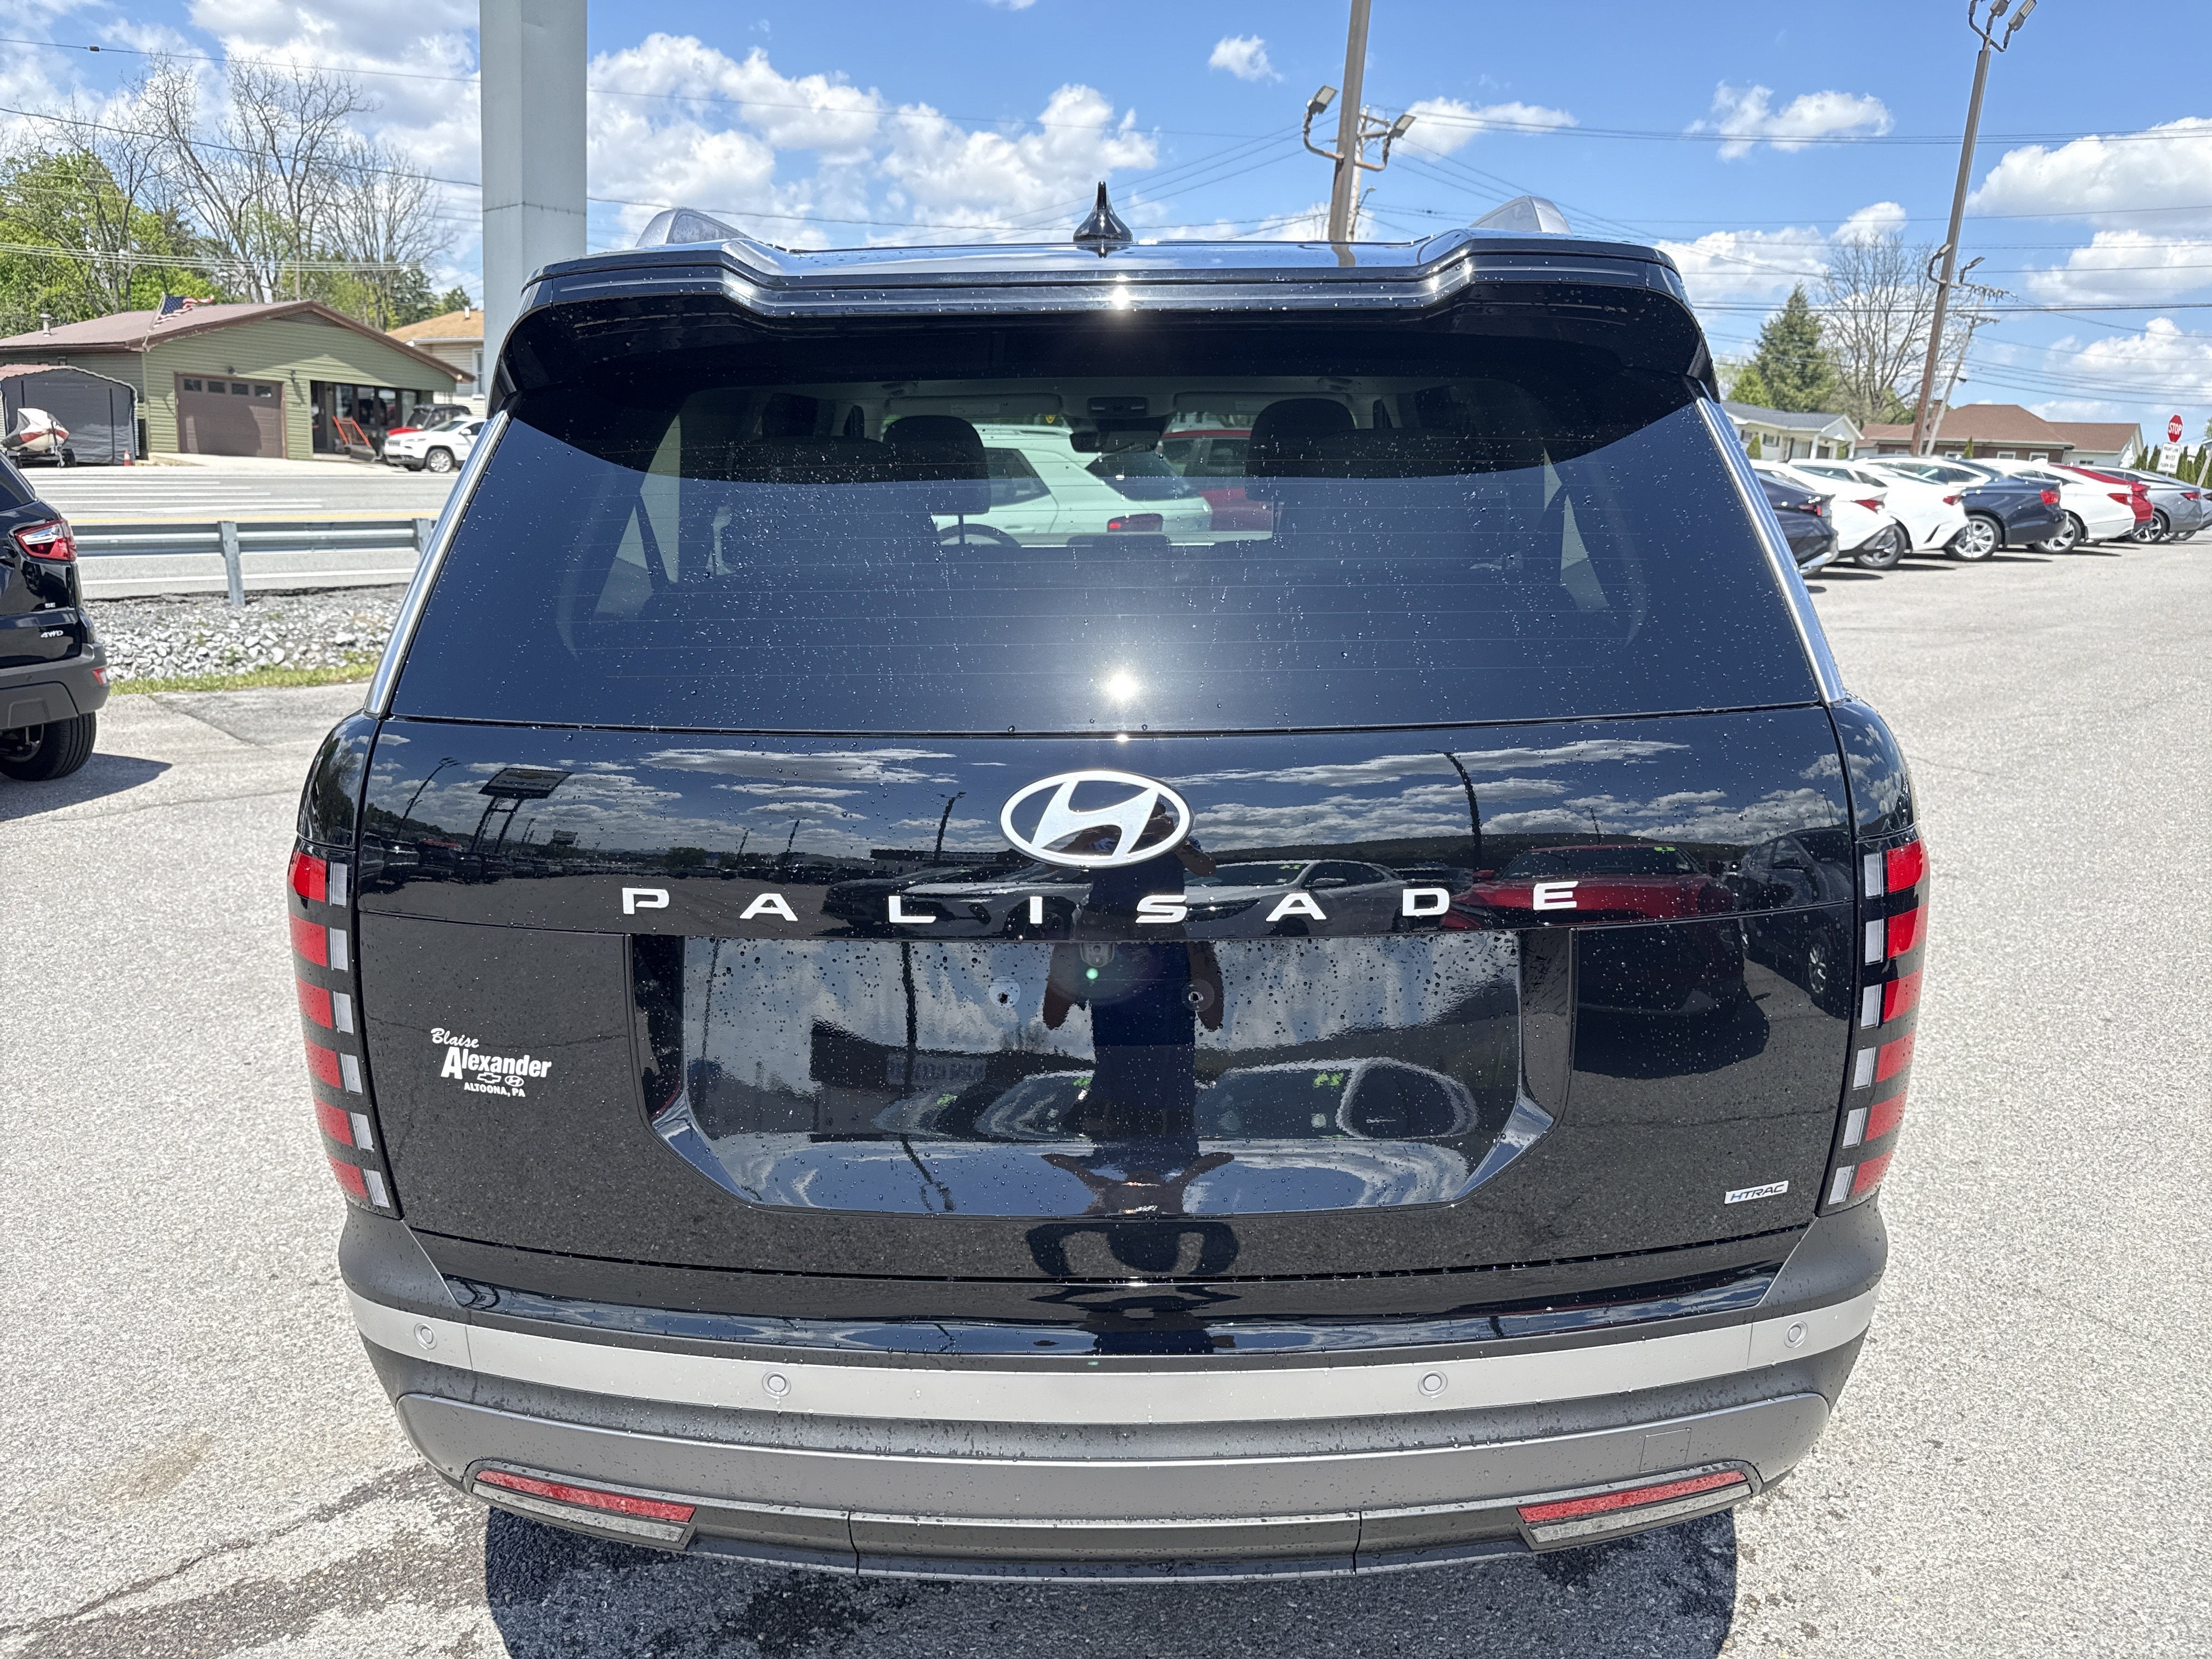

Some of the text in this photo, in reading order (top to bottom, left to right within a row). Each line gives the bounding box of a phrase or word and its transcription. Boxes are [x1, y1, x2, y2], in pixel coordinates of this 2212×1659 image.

[2168, 422, 2182, 435] STOP
[622, 881, 1579, 924] PALISADE
[431, 1028, 479, 1048] Blaise
[441, 1046, 552, 1079] Alexander
[464, 1082, 526, 1097] ALTOONA, PA
[1730, 1184, 1784, 1201] HTRAC
